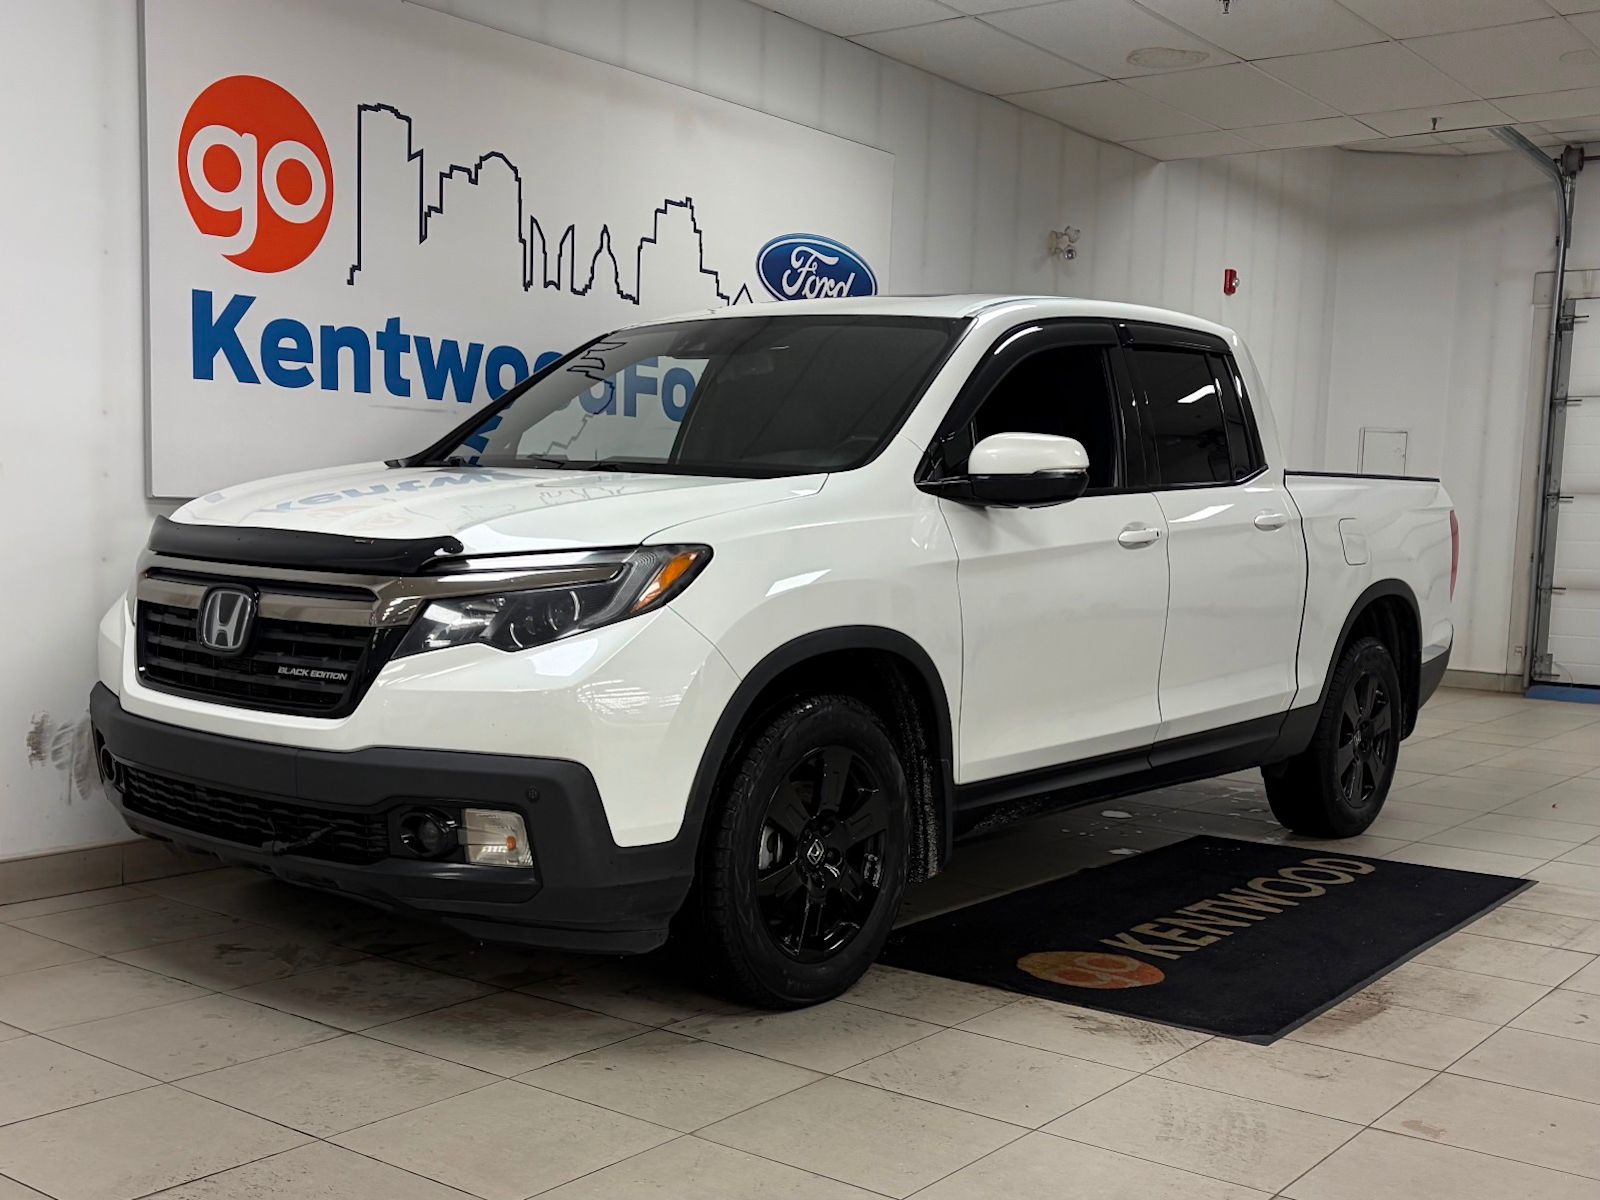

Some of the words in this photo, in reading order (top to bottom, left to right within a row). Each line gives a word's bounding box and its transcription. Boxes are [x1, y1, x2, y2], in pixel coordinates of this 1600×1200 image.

[187, 124, 327, 256] go
[782, 245, 856, 299] Ford
[277, 666, 309, 677] BLACK
[310, 669, 348, 681] EDITION
[1099, 857, 1376, 961] KENTWOOD
